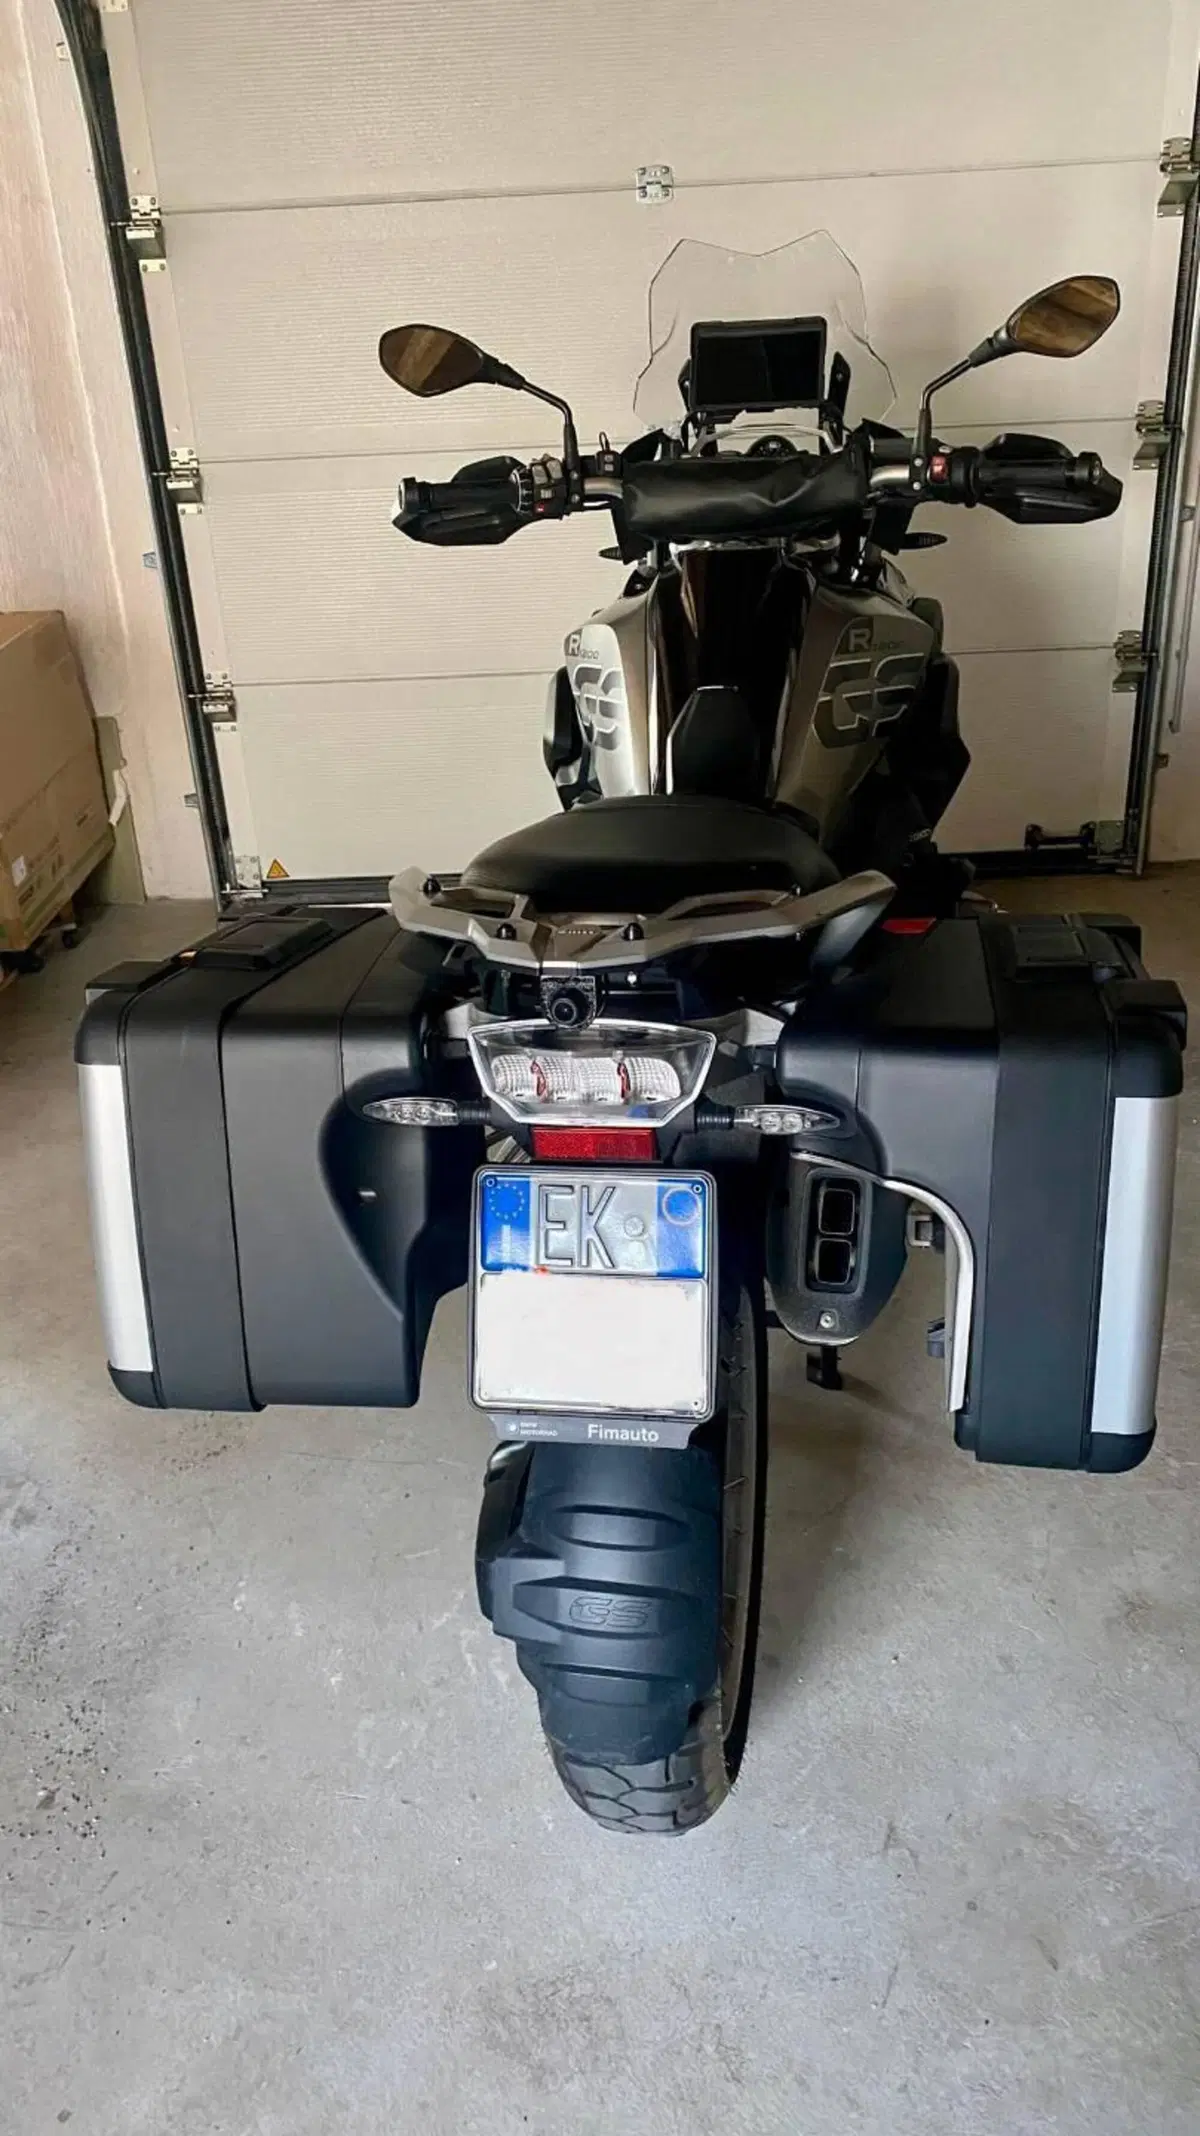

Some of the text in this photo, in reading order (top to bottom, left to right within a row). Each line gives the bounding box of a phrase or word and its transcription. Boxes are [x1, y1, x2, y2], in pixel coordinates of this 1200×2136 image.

[568, 634, 580, 655] R
[848, 628, 871, 652] R
[538, 1184, 616, 1268] EK
[587, 1423, 660, 1443] Fimauto
[569, 1596, 650, 1628] GS
